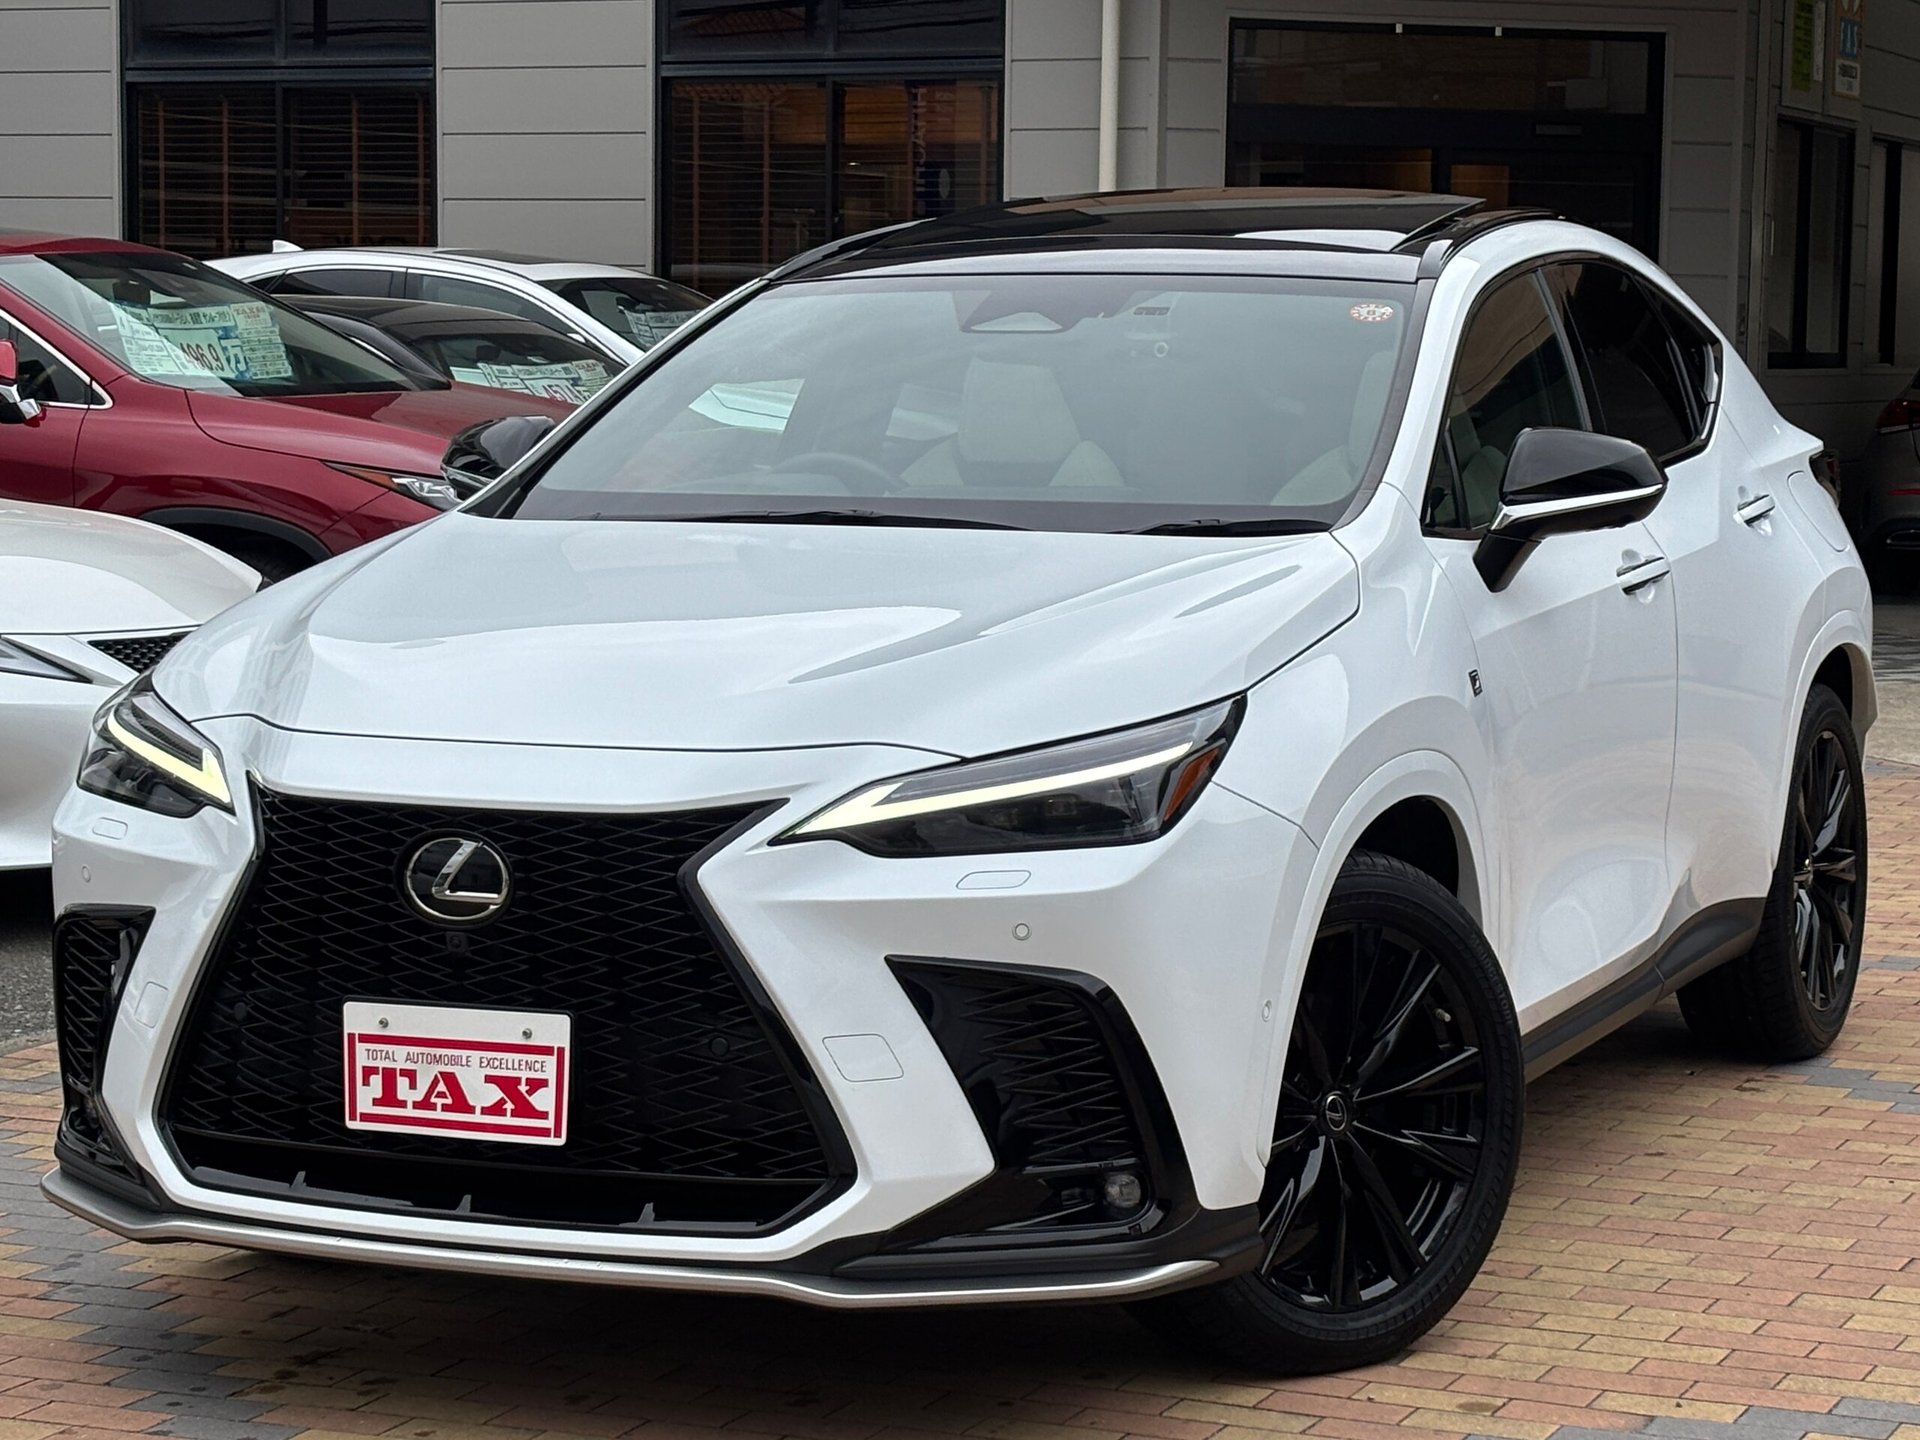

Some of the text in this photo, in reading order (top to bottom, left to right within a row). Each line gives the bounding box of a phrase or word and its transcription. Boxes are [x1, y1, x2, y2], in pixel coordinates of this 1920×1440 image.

[365, 1048, 547, 1073] TOTAL AUTOMOBILE EXCELLENCE
[361, 1065, 549, 1120] TAX
